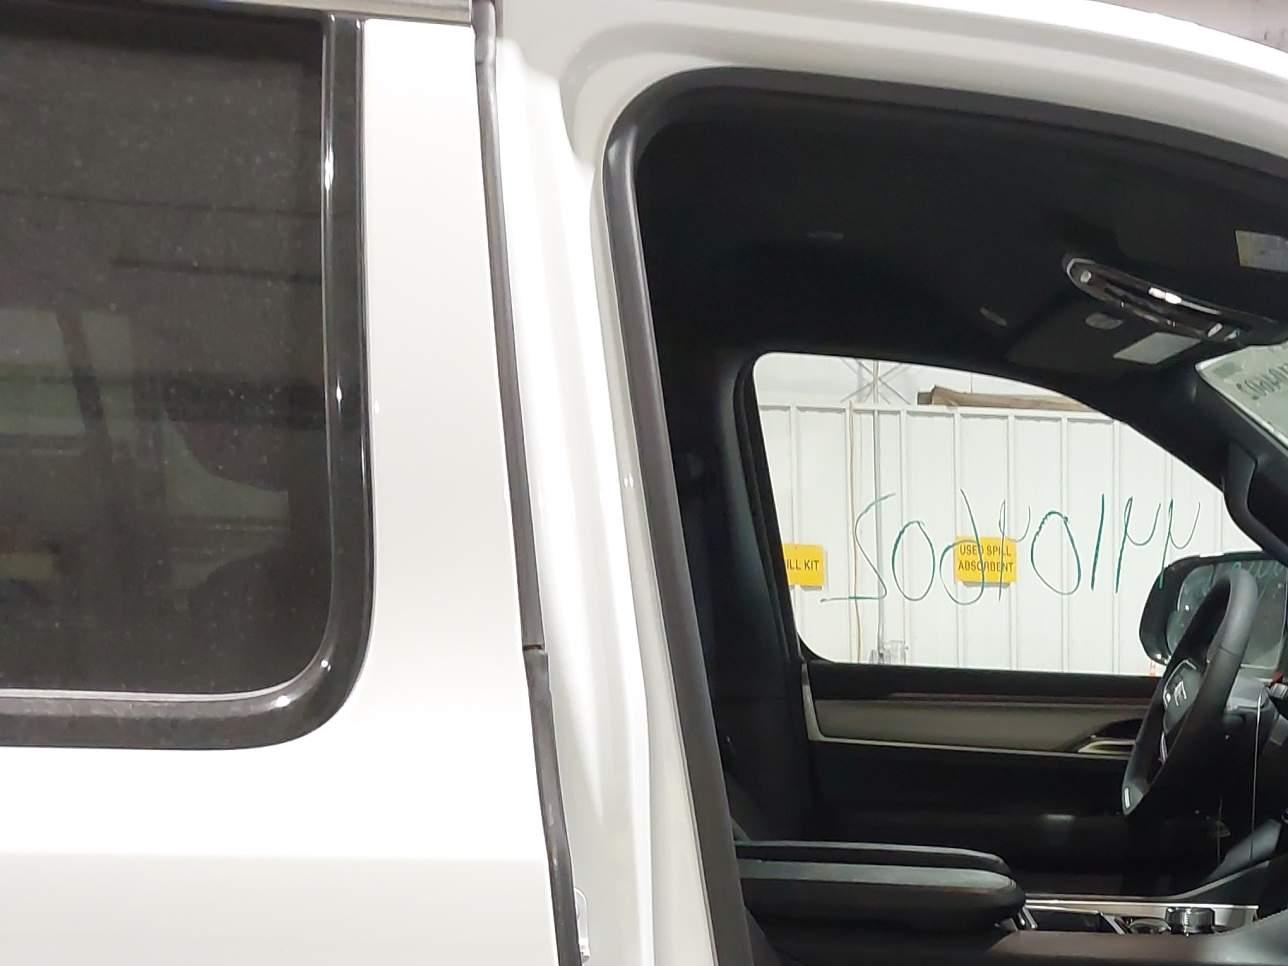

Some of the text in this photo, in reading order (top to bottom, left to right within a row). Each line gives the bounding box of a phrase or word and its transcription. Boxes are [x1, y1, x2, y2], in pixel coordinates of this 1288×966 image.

[959, 544, 985, 556] USED
[804, 559, 820, 571] KIT
[957, 560, 1015, 573] ABSORBENT
